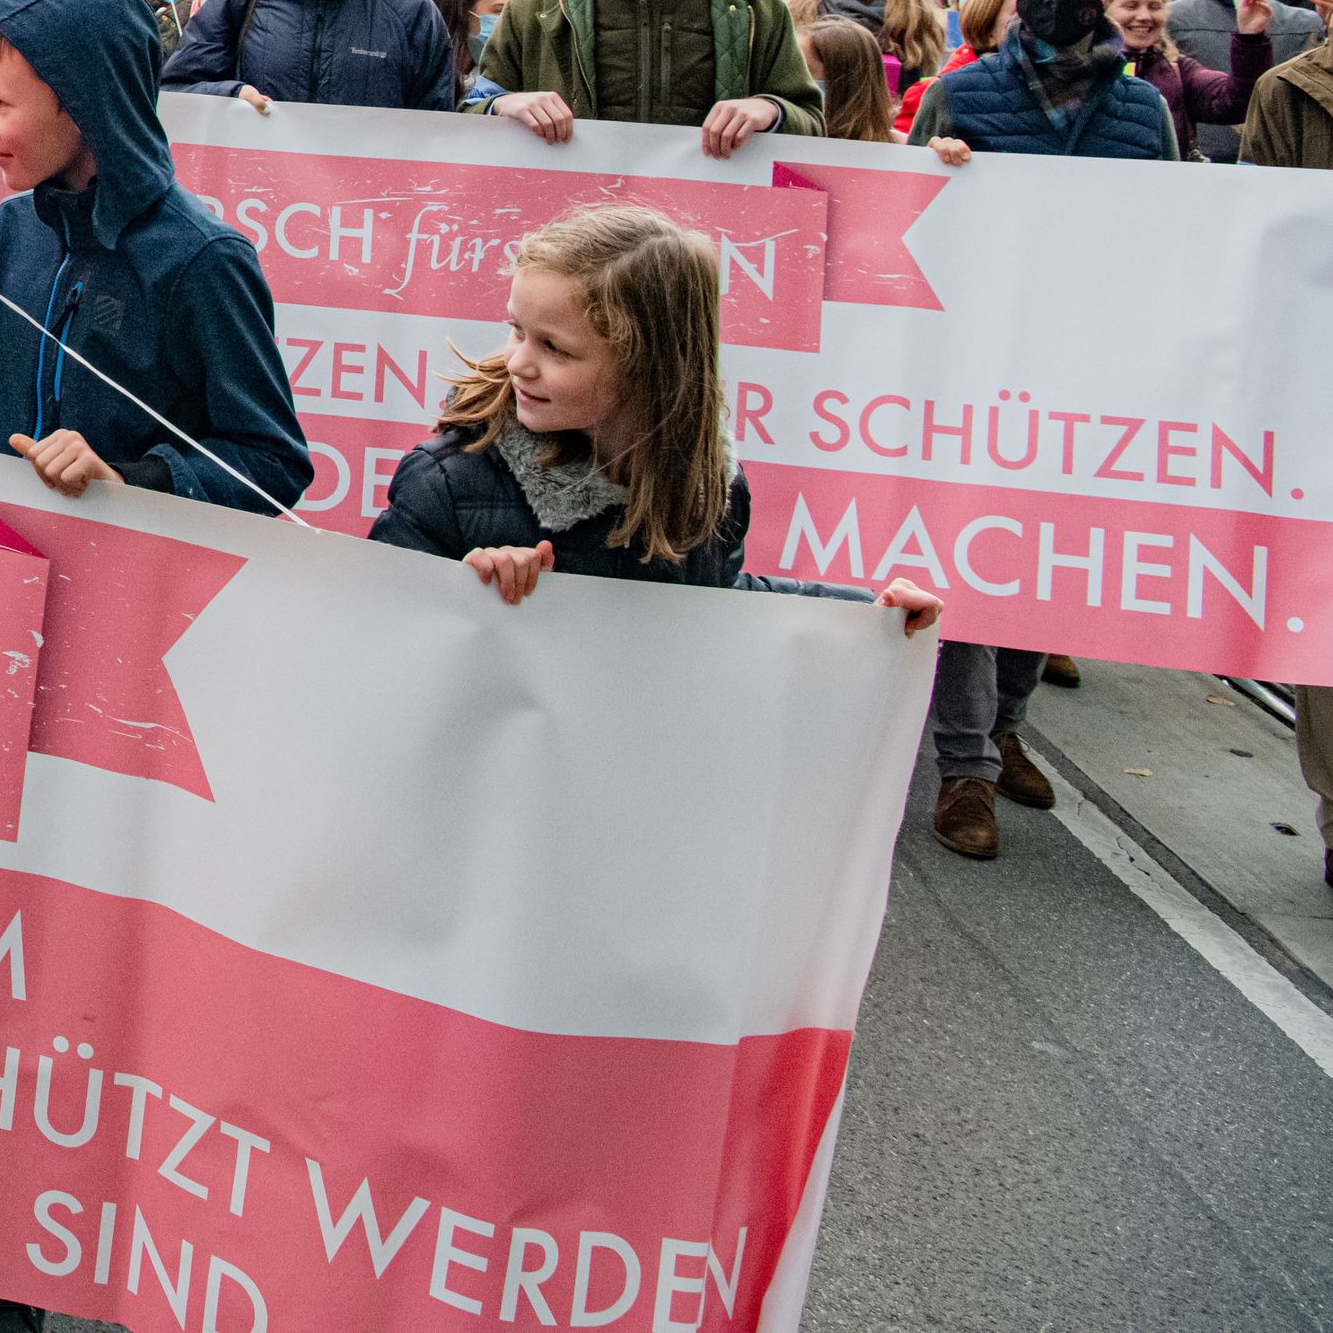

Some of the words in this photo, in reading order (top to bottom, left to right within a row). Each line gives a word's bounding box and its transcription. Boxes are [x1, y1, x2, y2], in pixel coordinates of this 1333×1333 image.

[808, 388, 1306, 500] SCHÜTZEN.
[778, 490, 1306, 634] MACHEN.
[25, 1189, 269, 1333] SIND
[303, 1155, 749, 1333] WERDEN
